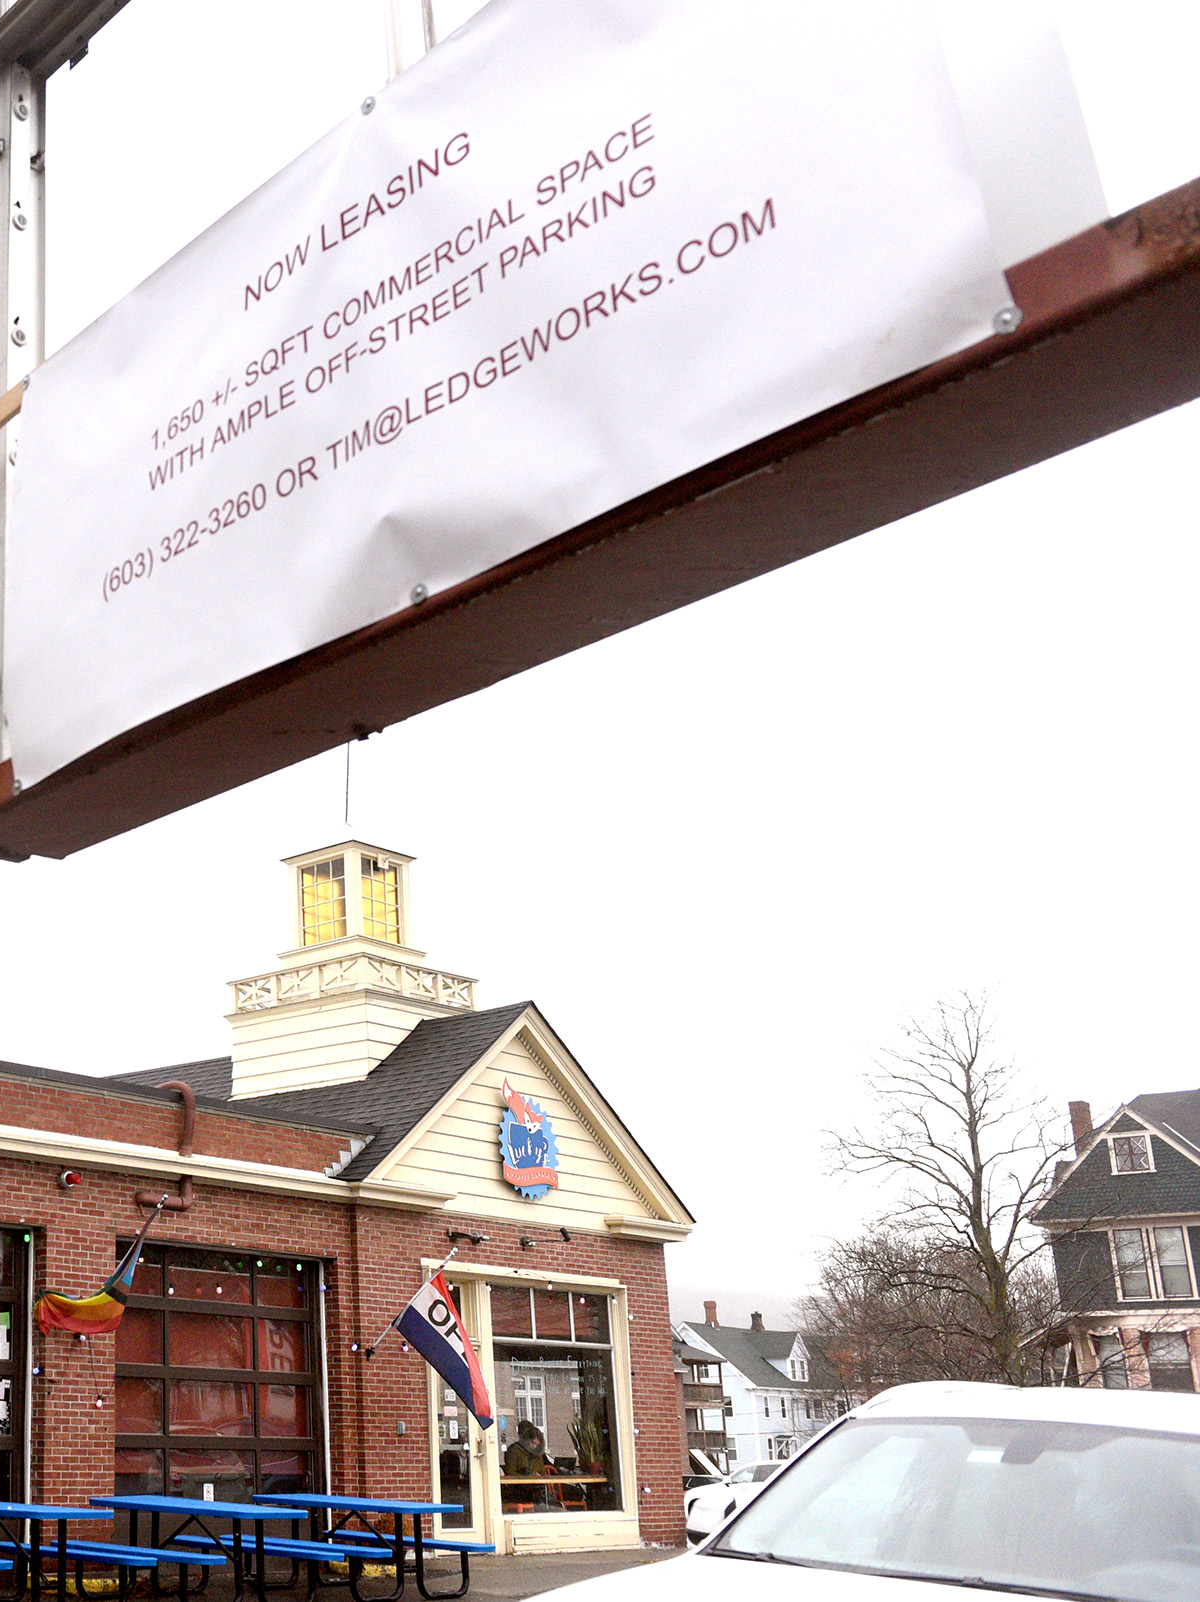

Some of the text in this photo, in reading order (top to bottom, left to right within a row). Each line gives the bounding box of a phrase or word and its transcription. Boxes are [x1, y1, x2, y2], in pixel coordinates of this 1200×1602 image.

[148, 165, 657, 491] WITH AMPLE OFF-STREET PARKING
[151, 112, 655, 451] 1,650 +/- SQFT COMMERCIAL SPACE
[244, 131, 471, 312] NOW LEASING
[102, 197, 777, 603] (603) 322-3260 OR TIM@LEDGEWORKS.COM
